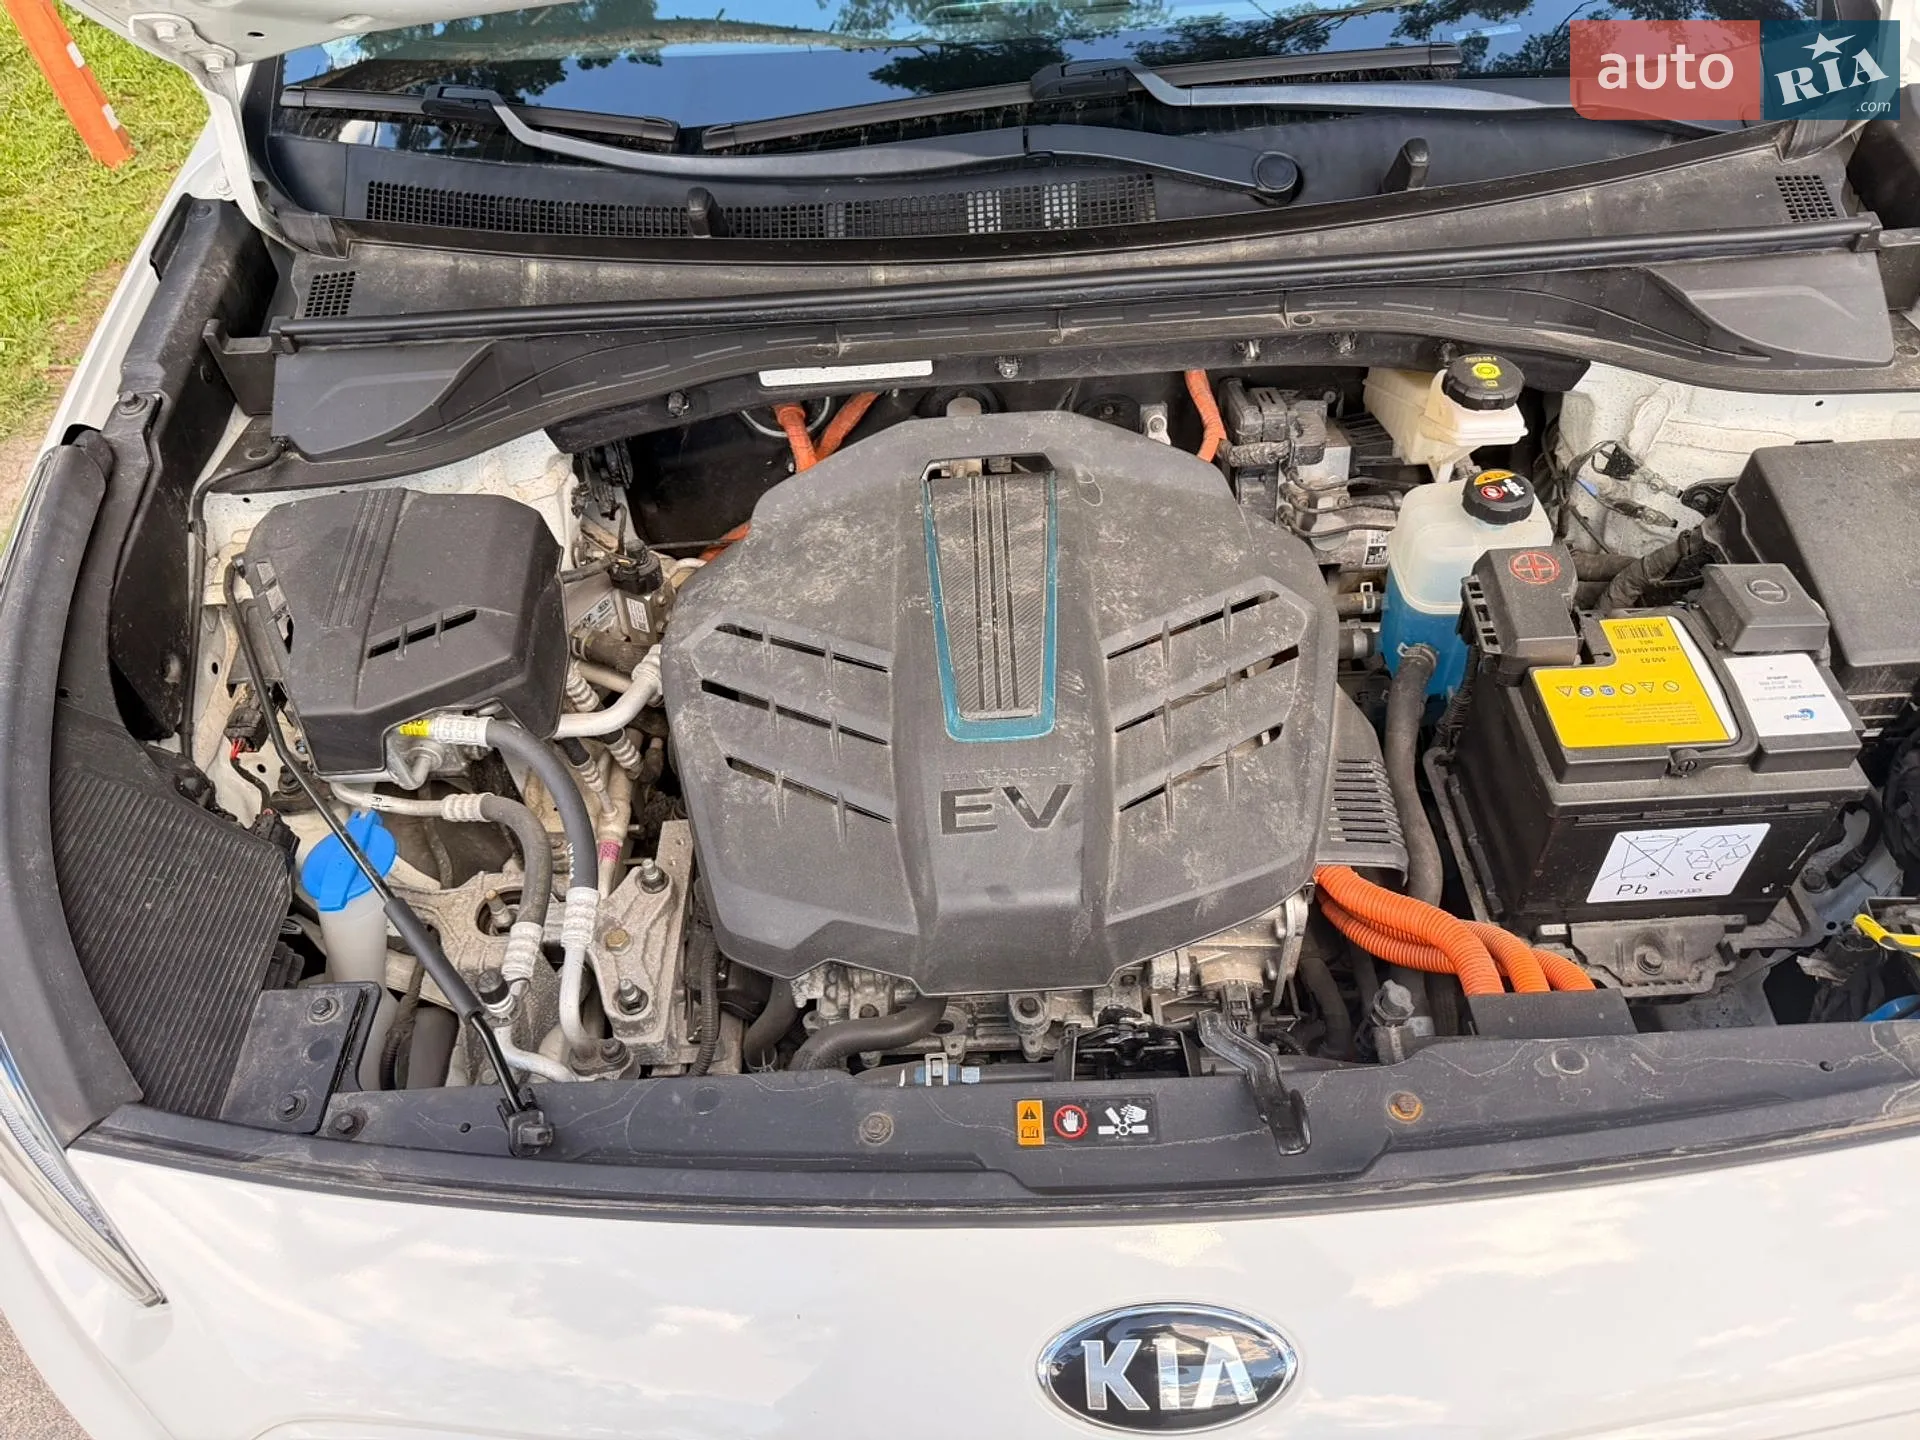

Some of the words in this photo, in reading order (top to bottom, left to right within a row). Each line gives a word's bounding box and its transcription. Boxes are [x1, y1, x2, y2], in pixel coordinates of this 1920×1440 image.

[940, 783, 1074, 835] EV
[1616, 884, 1648, 895] Pb
[1080, 1335, 1258, 1411] KIA
